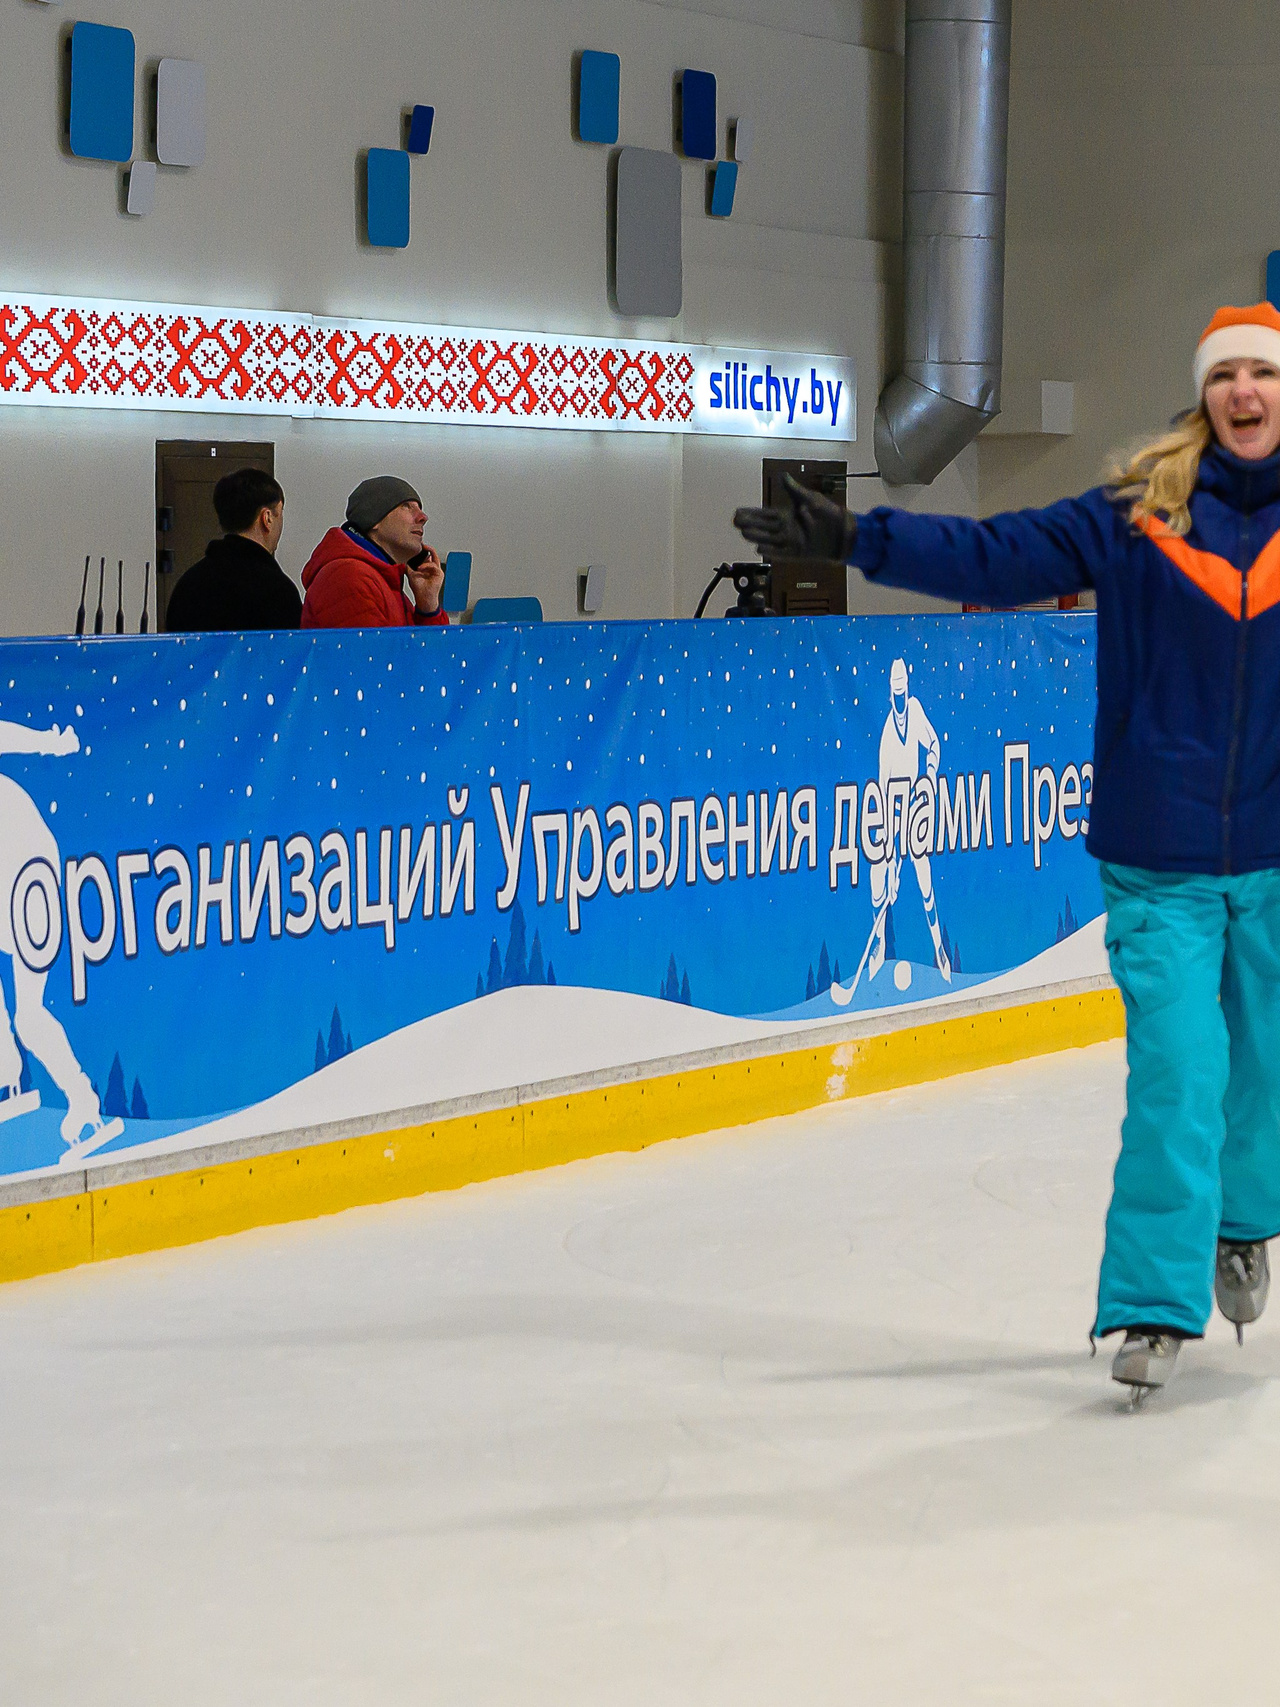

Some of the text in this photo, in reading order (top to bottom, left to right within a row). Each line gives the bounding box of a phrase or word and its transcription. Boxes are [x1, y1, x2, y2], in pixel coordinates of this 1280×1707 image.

[708, 361, 843, 427] silichy.by
[11, 784, 476, 1004] организаций
[489, 780, 819, 932] Управления
[829, 770, 994, 891] делами
